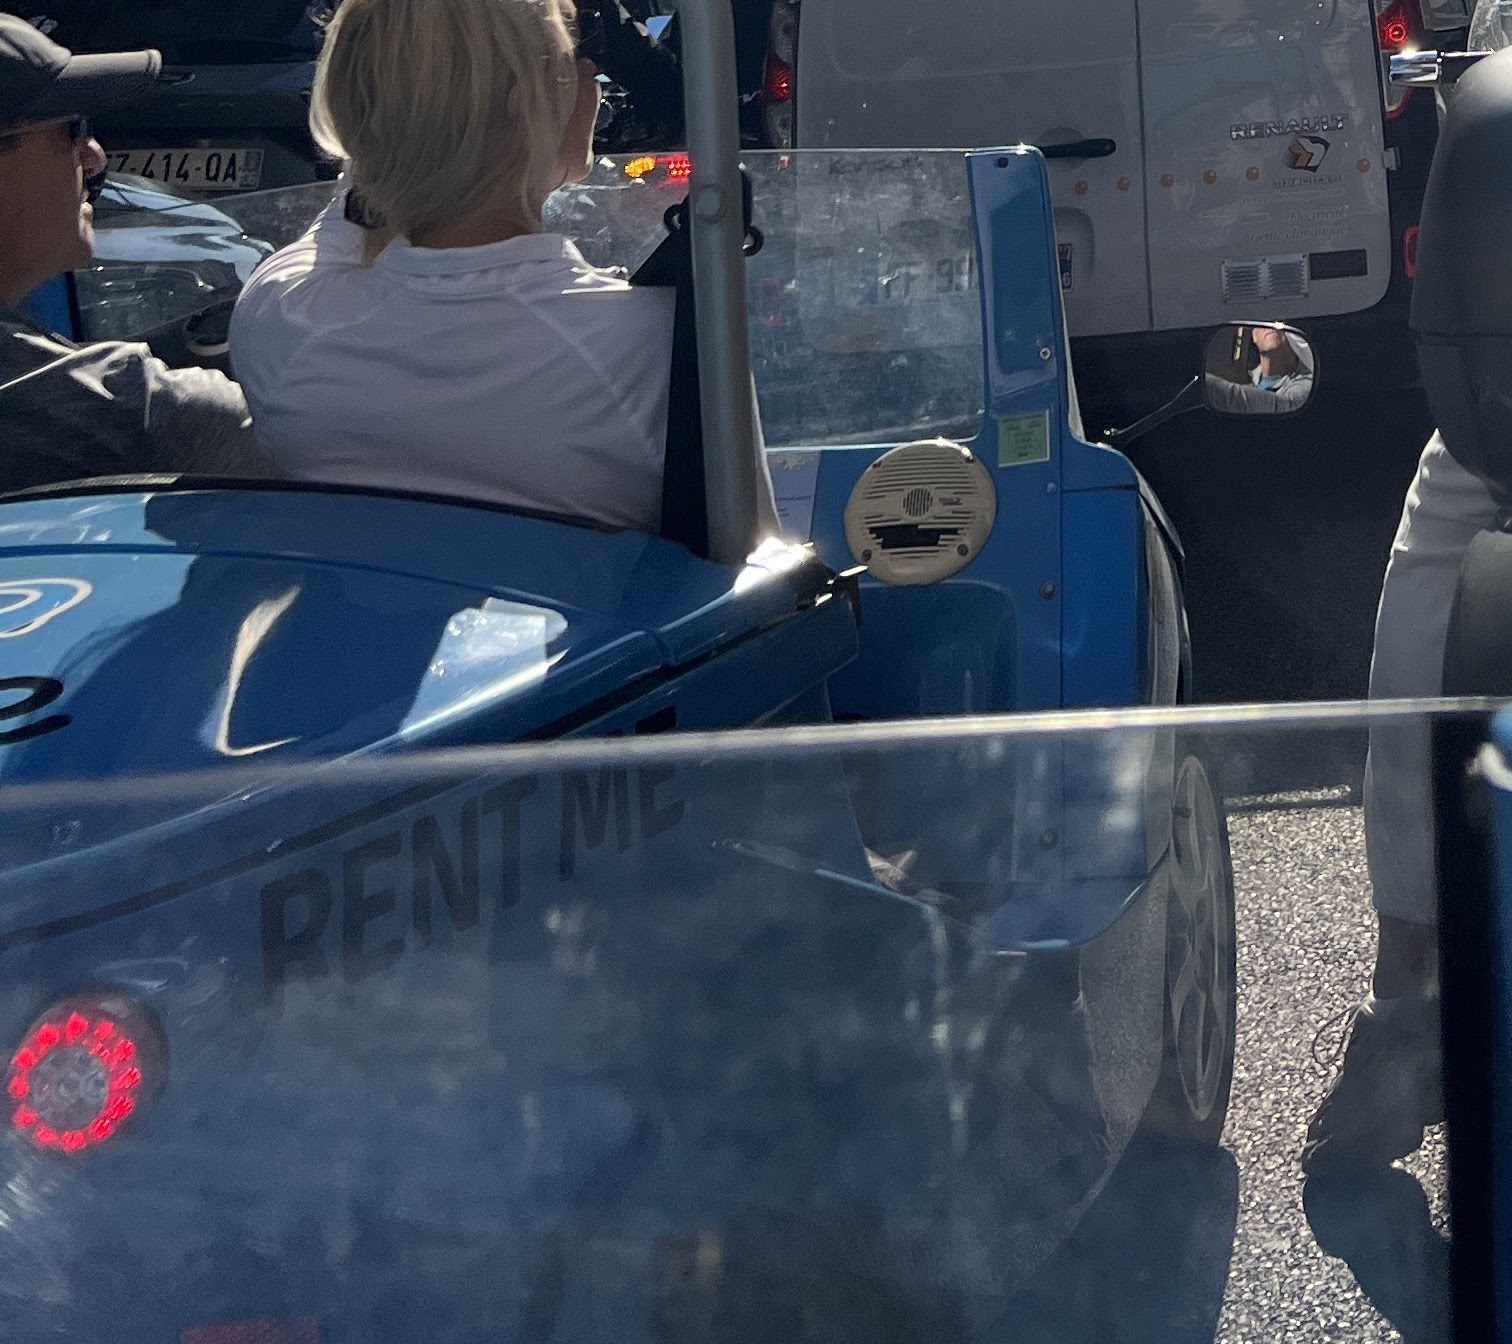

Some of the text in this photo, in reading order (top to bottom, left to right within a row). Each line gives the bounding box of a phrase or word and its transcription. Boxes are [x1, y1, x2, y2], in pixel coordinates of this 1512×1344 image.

[1229, 113, 1349, 142] RENAULT
[259, 705, 685, 1023] RENT ME
